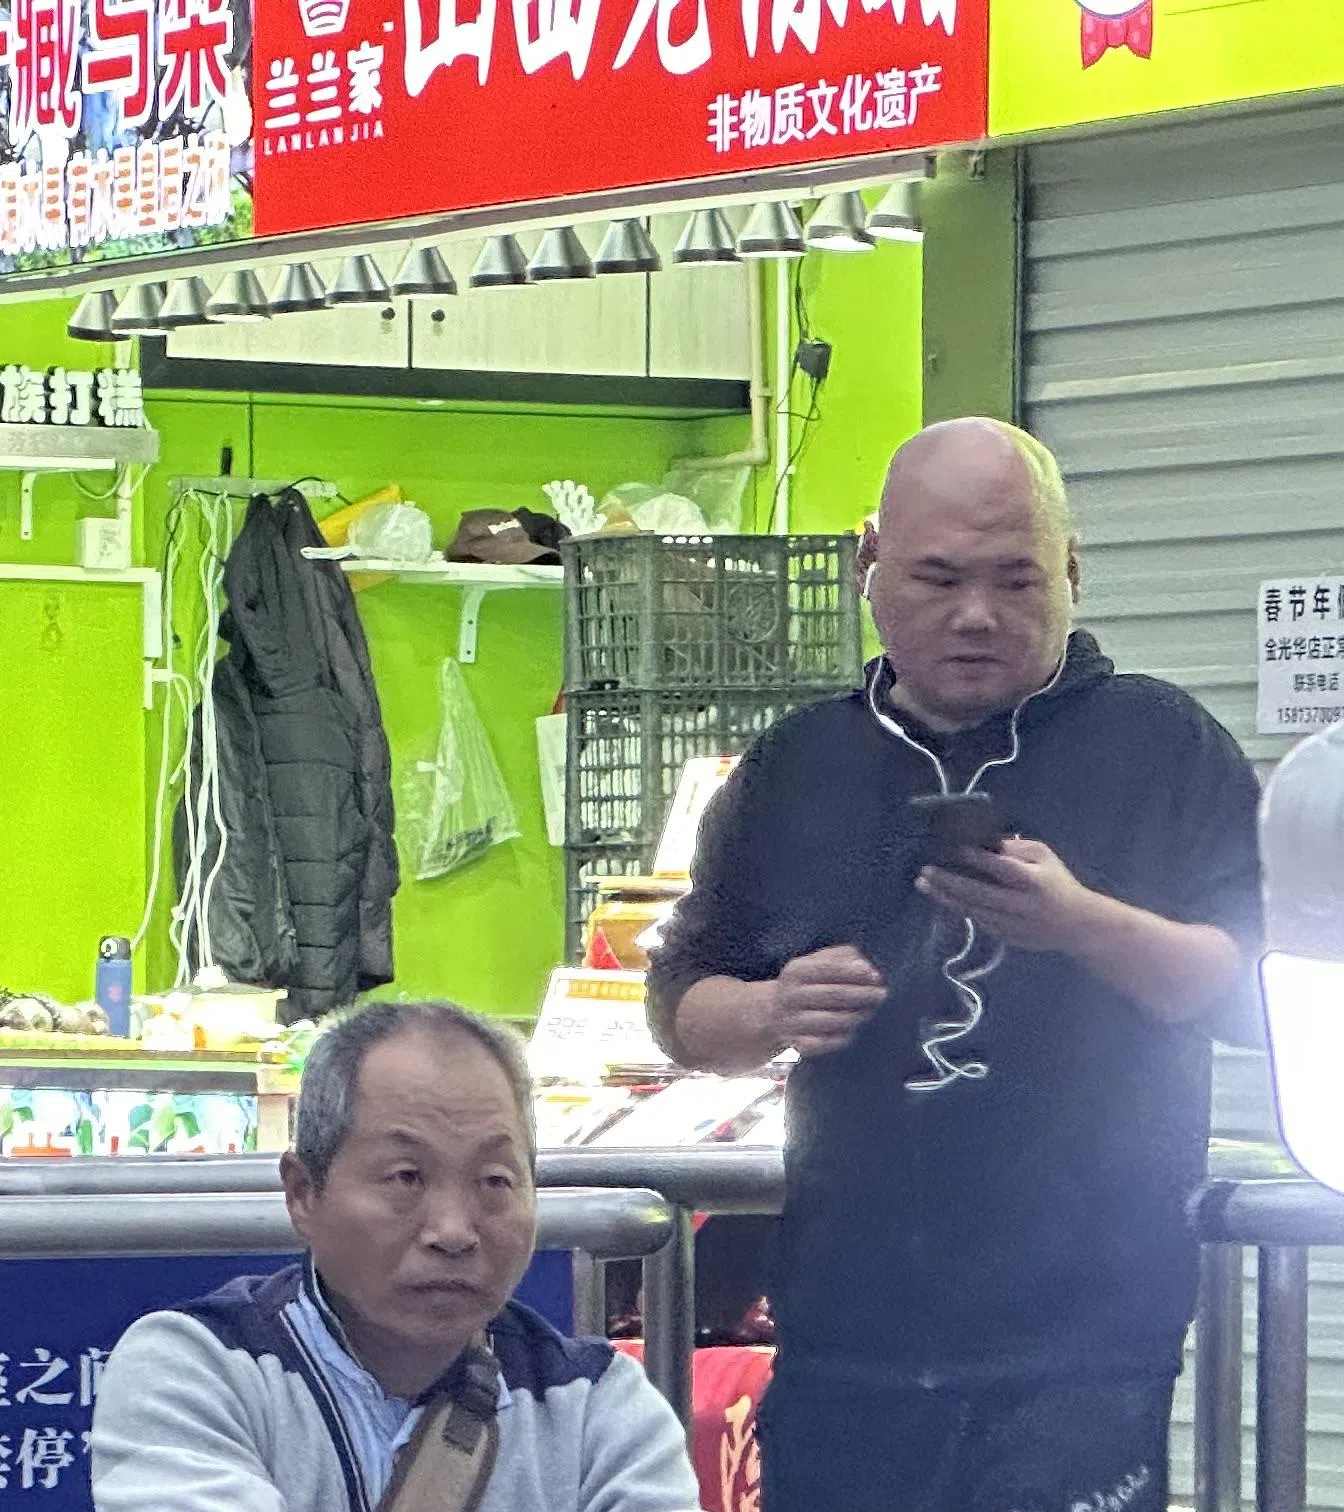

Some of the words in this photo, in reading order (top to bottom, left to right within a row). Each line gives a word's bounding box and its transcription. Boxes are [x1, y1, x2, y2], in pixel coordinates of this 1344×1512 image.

[264, 41, 384, 129] 兰兰家
[707, 62, 943, 153] 非物质文化遗产
